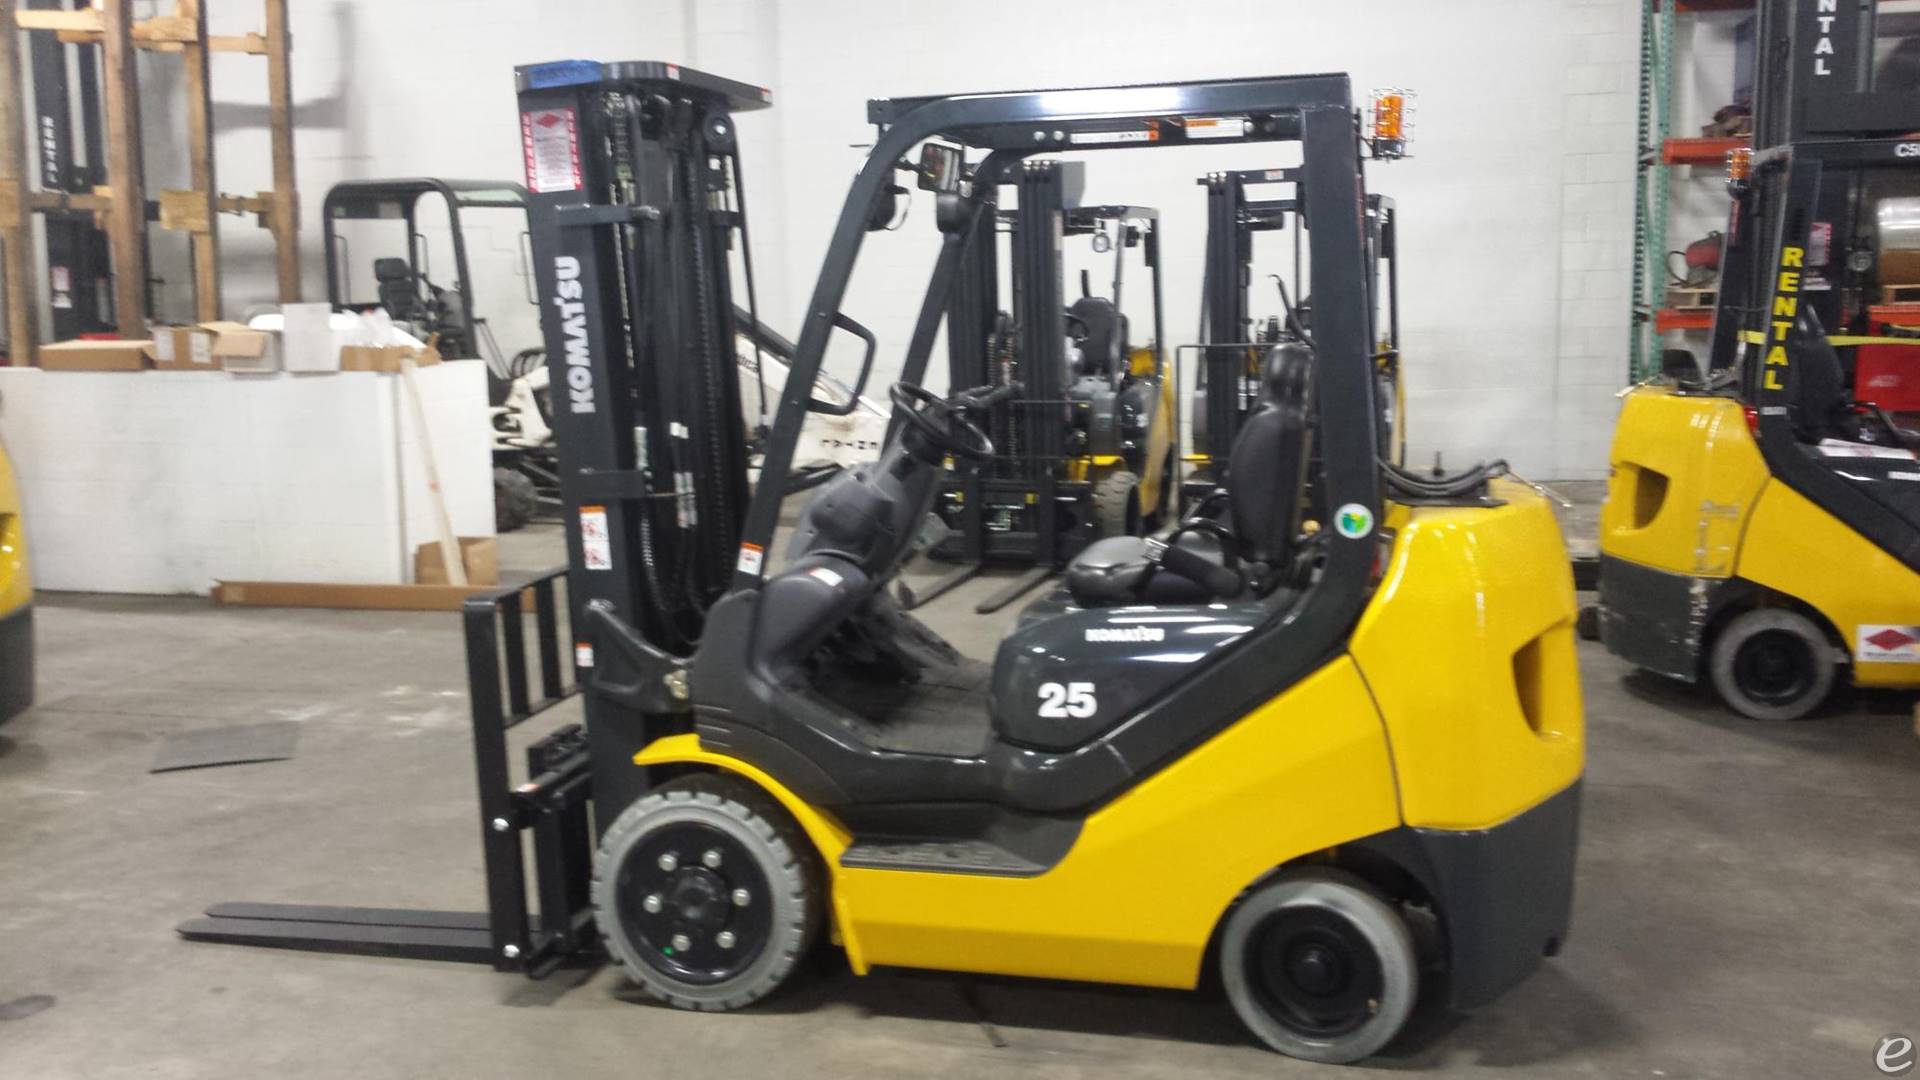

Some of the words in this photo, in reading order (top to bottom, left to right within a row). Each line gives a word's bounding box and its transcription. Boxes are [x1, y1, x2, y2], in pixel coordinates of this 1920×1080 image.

[41, 115, 59, 184] RENTAL
[553, 256, 596, 414] KOMATSU
[1763, 246, 1805, 390] RENTAL
[1037, 681, 1098, 718] 25
